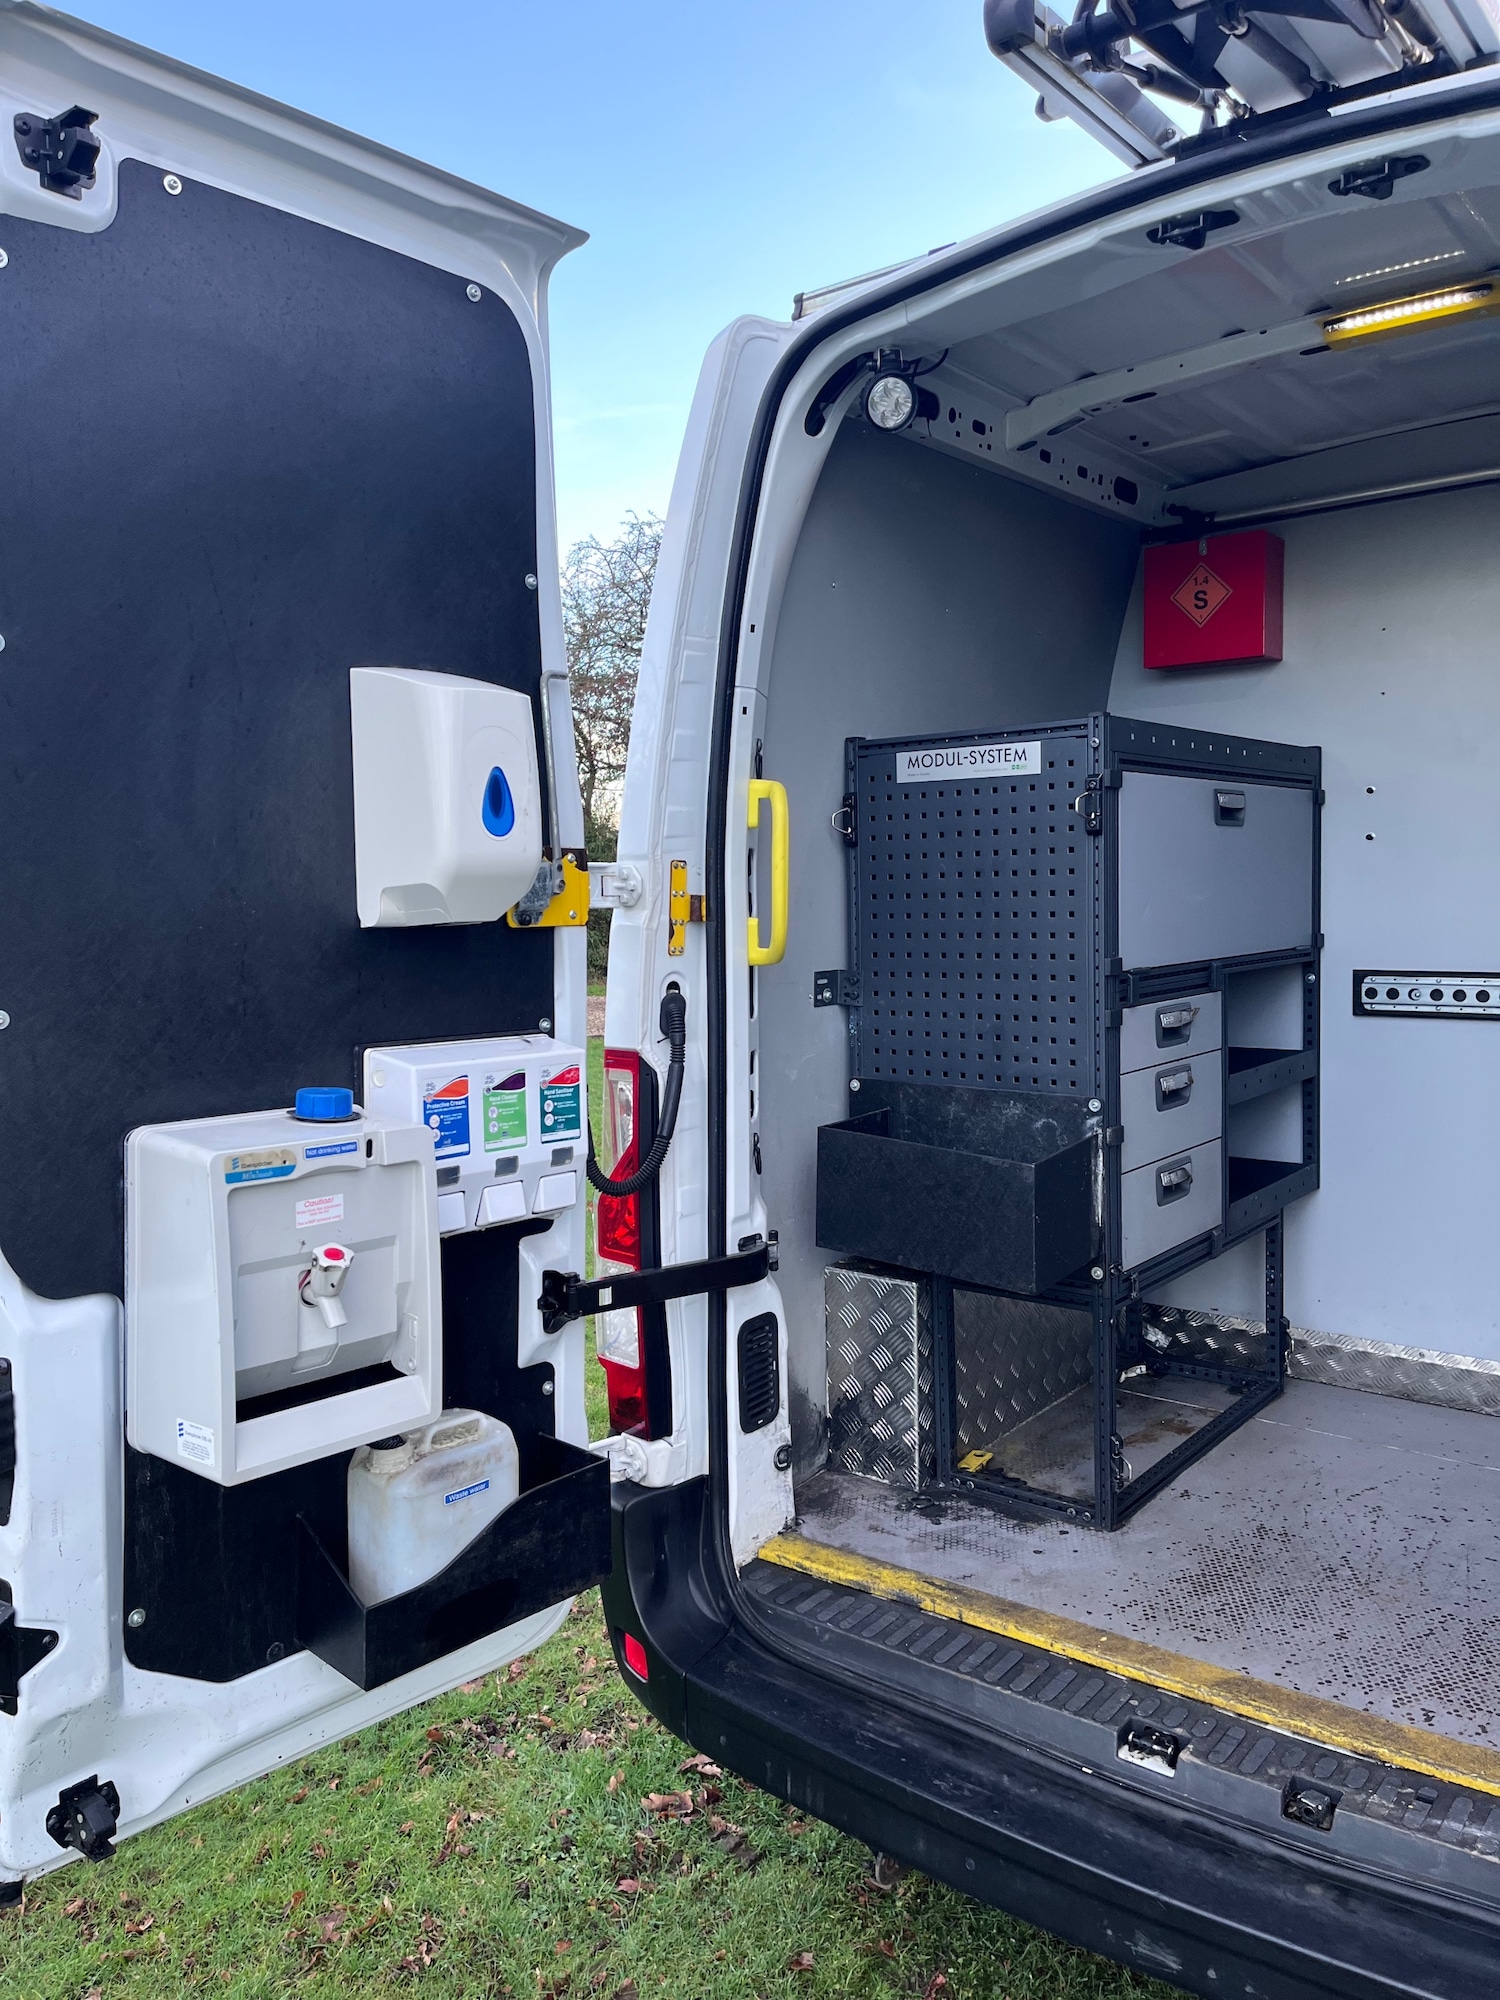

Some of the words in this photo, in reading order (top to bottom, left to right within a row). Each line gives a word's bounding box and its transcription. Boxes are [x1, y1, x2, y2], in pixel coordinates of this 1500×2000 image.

[1193, 576, 1209, 586] 1.4
[1193, 590, 1209, 610] S
[907, 747, 1028, 770] MODUL-SYSTEM
[426, 1101, 449, 1109] Protective
[306, 1148, 318, 1156] Not
[318, 1145, 341, 1155] drinking
[341, 1143, 357, 1151] water
[304, 1196, 335, 1208] Caution!
[448, 1490, 469, 1502] Waste
[469, 1483, 486, 1494] water
